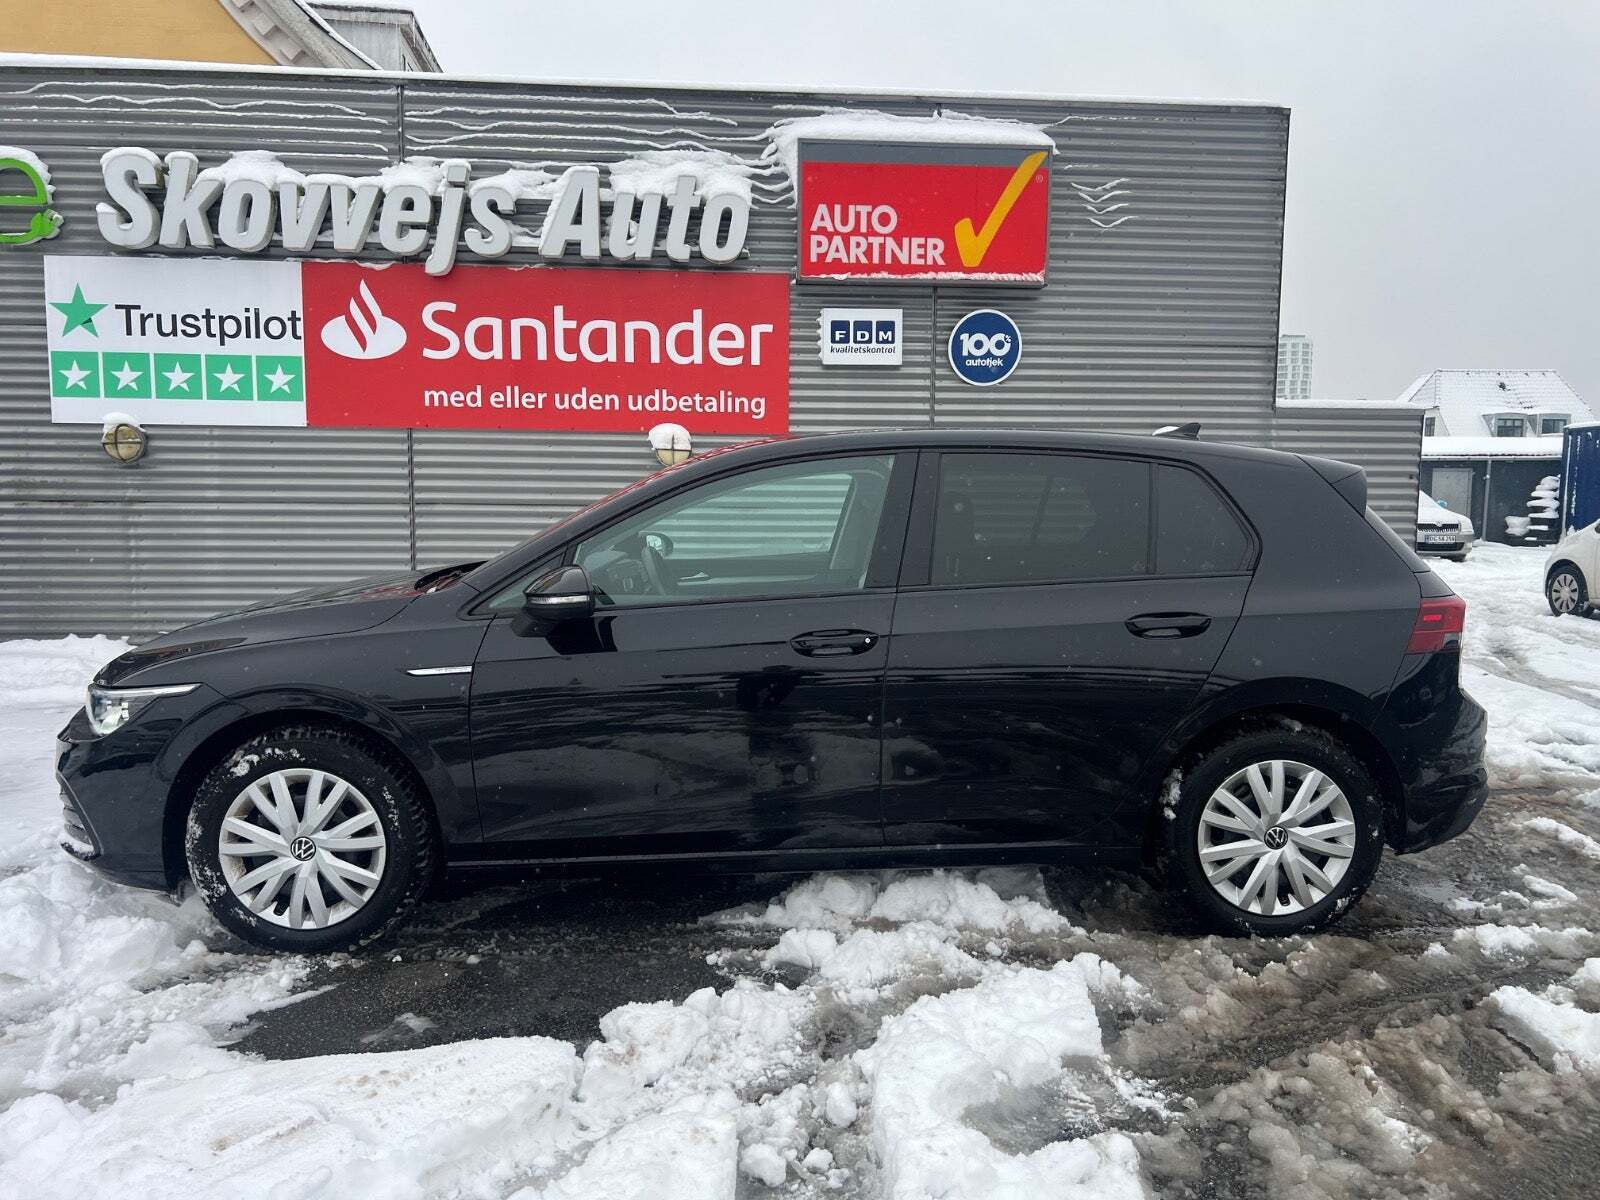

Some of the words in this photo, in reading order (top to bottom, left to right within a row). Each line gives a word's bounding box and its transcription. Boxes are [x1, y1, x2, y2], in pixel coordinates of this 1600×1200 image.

[96, 148, 516, 276] Skovvejs
[538, 164, 749, 264] Auto
[809, 203, 898, 234] AUTO
[809, 235, 946, 266] PARTNER
[115, 303, 302, 346] Trustpilot
[421, 301, 774, 366] Santander
[830, 345, 896, 354] kvalitetskontrol
[423, 385, 482, 408] med
[489, 386, 548, 409] eller
[554, 388, 620, 411] uden
[627, 389, 767, 419] udbetaling
